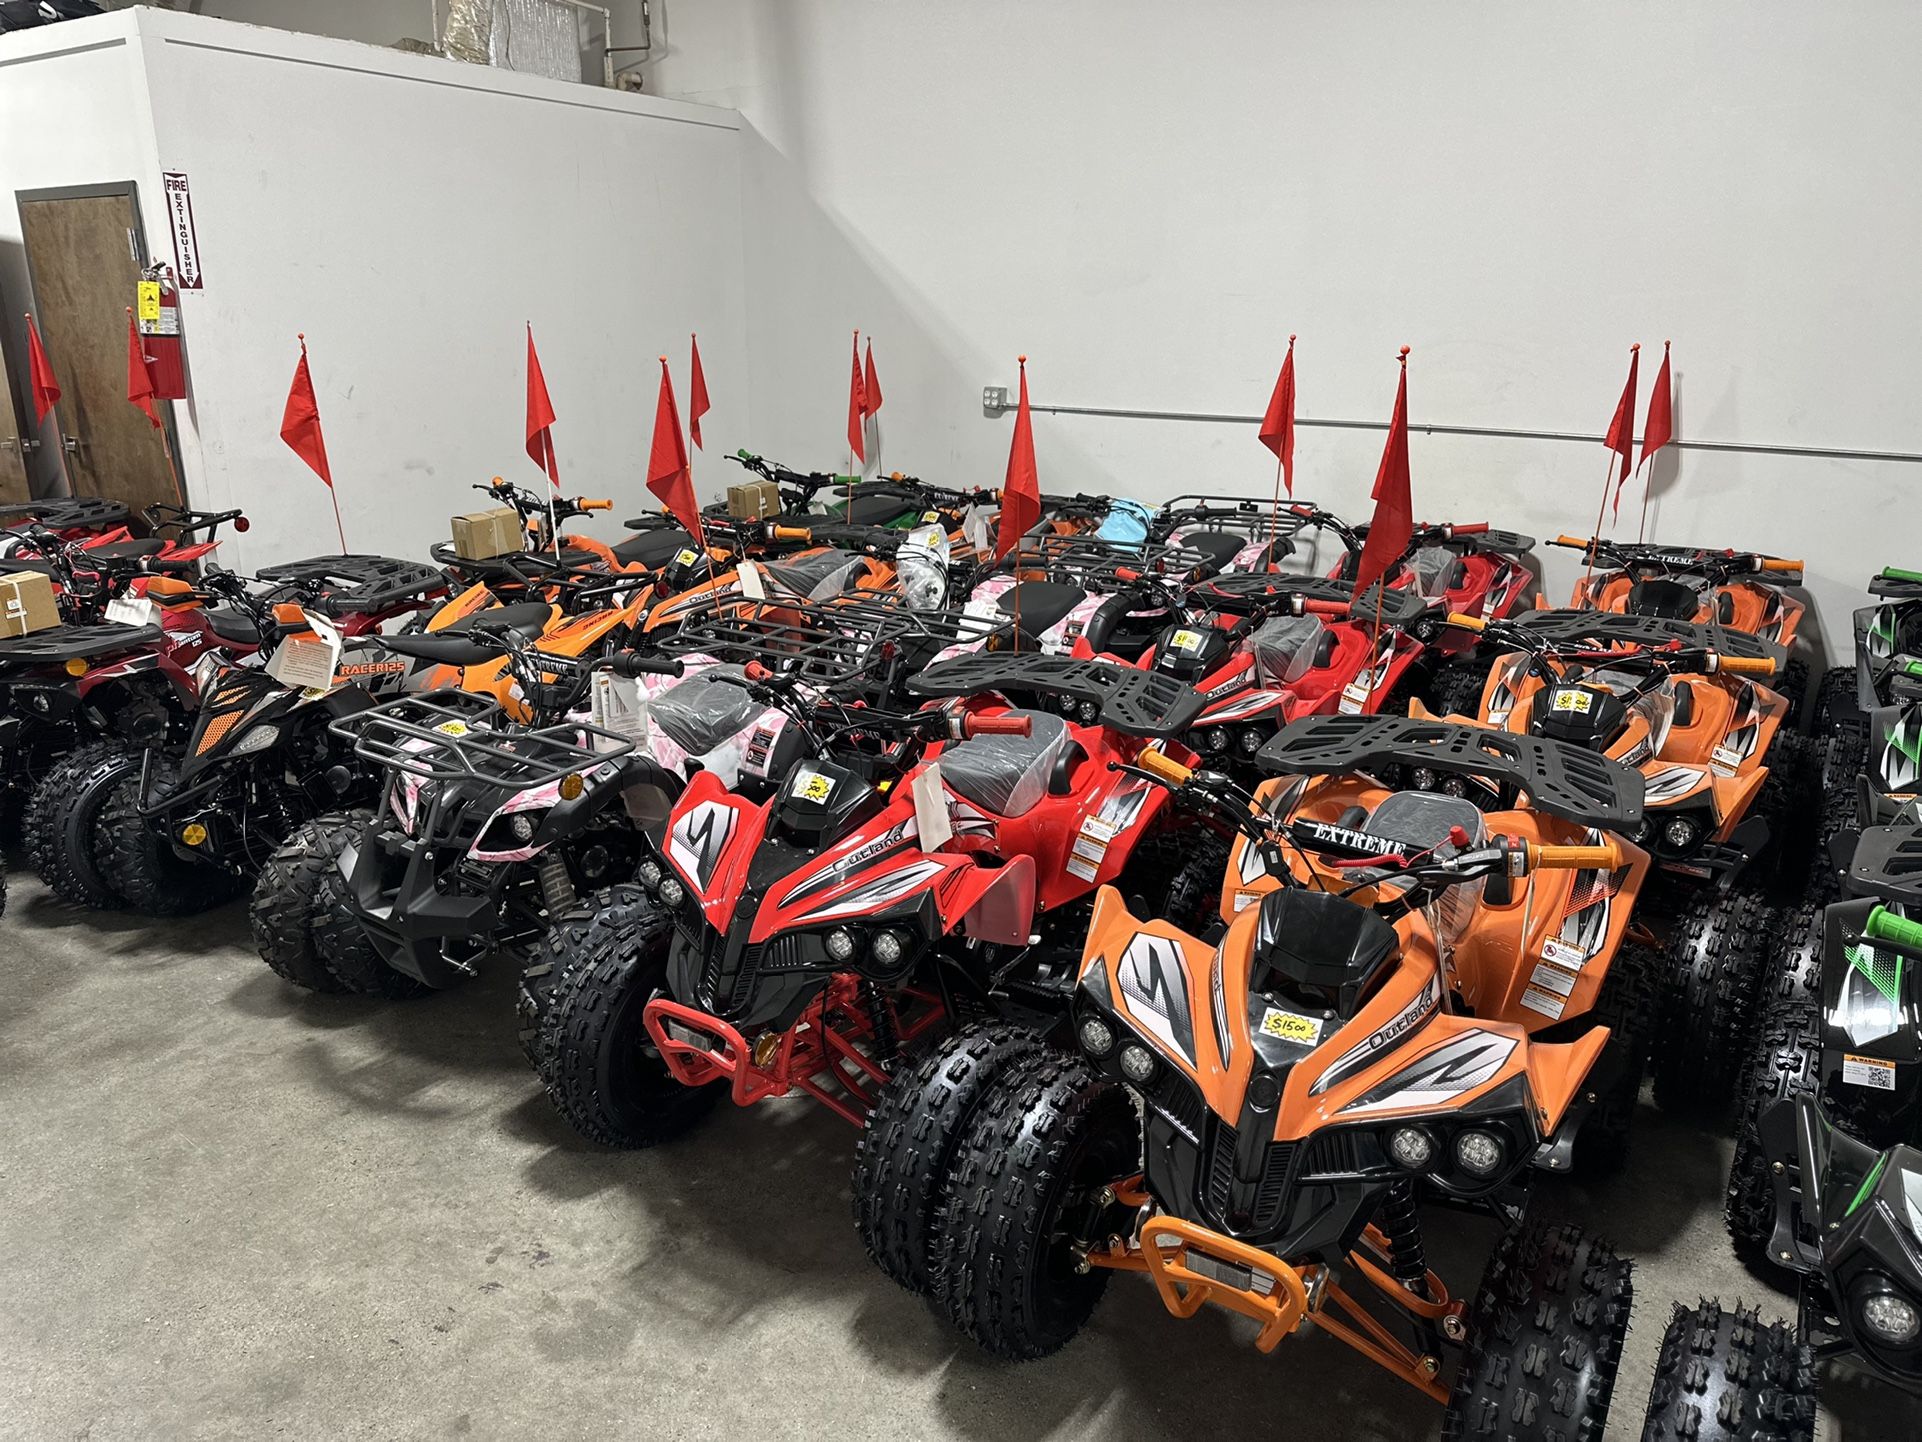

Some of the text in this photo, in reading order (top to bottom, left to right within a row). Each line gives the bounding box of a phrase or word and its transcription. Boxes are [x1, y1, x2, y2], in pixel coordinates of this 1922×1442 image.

[166, 180, 187, 192] FIRE
[174, 193, 195, 283] EXTINGUISHER
[689, 584, 732, 604] Outand
[341, 661, 406, 675] RACER125
[1313, 823, 1407, 855] EXTREME
[832, 829, 905, 872] Outland
[1272, 1018, 1306, 1032] $1500
[1368, 989, 1433, 1050] Outland
[1858, 1057, 1888, 1067] WARNING
